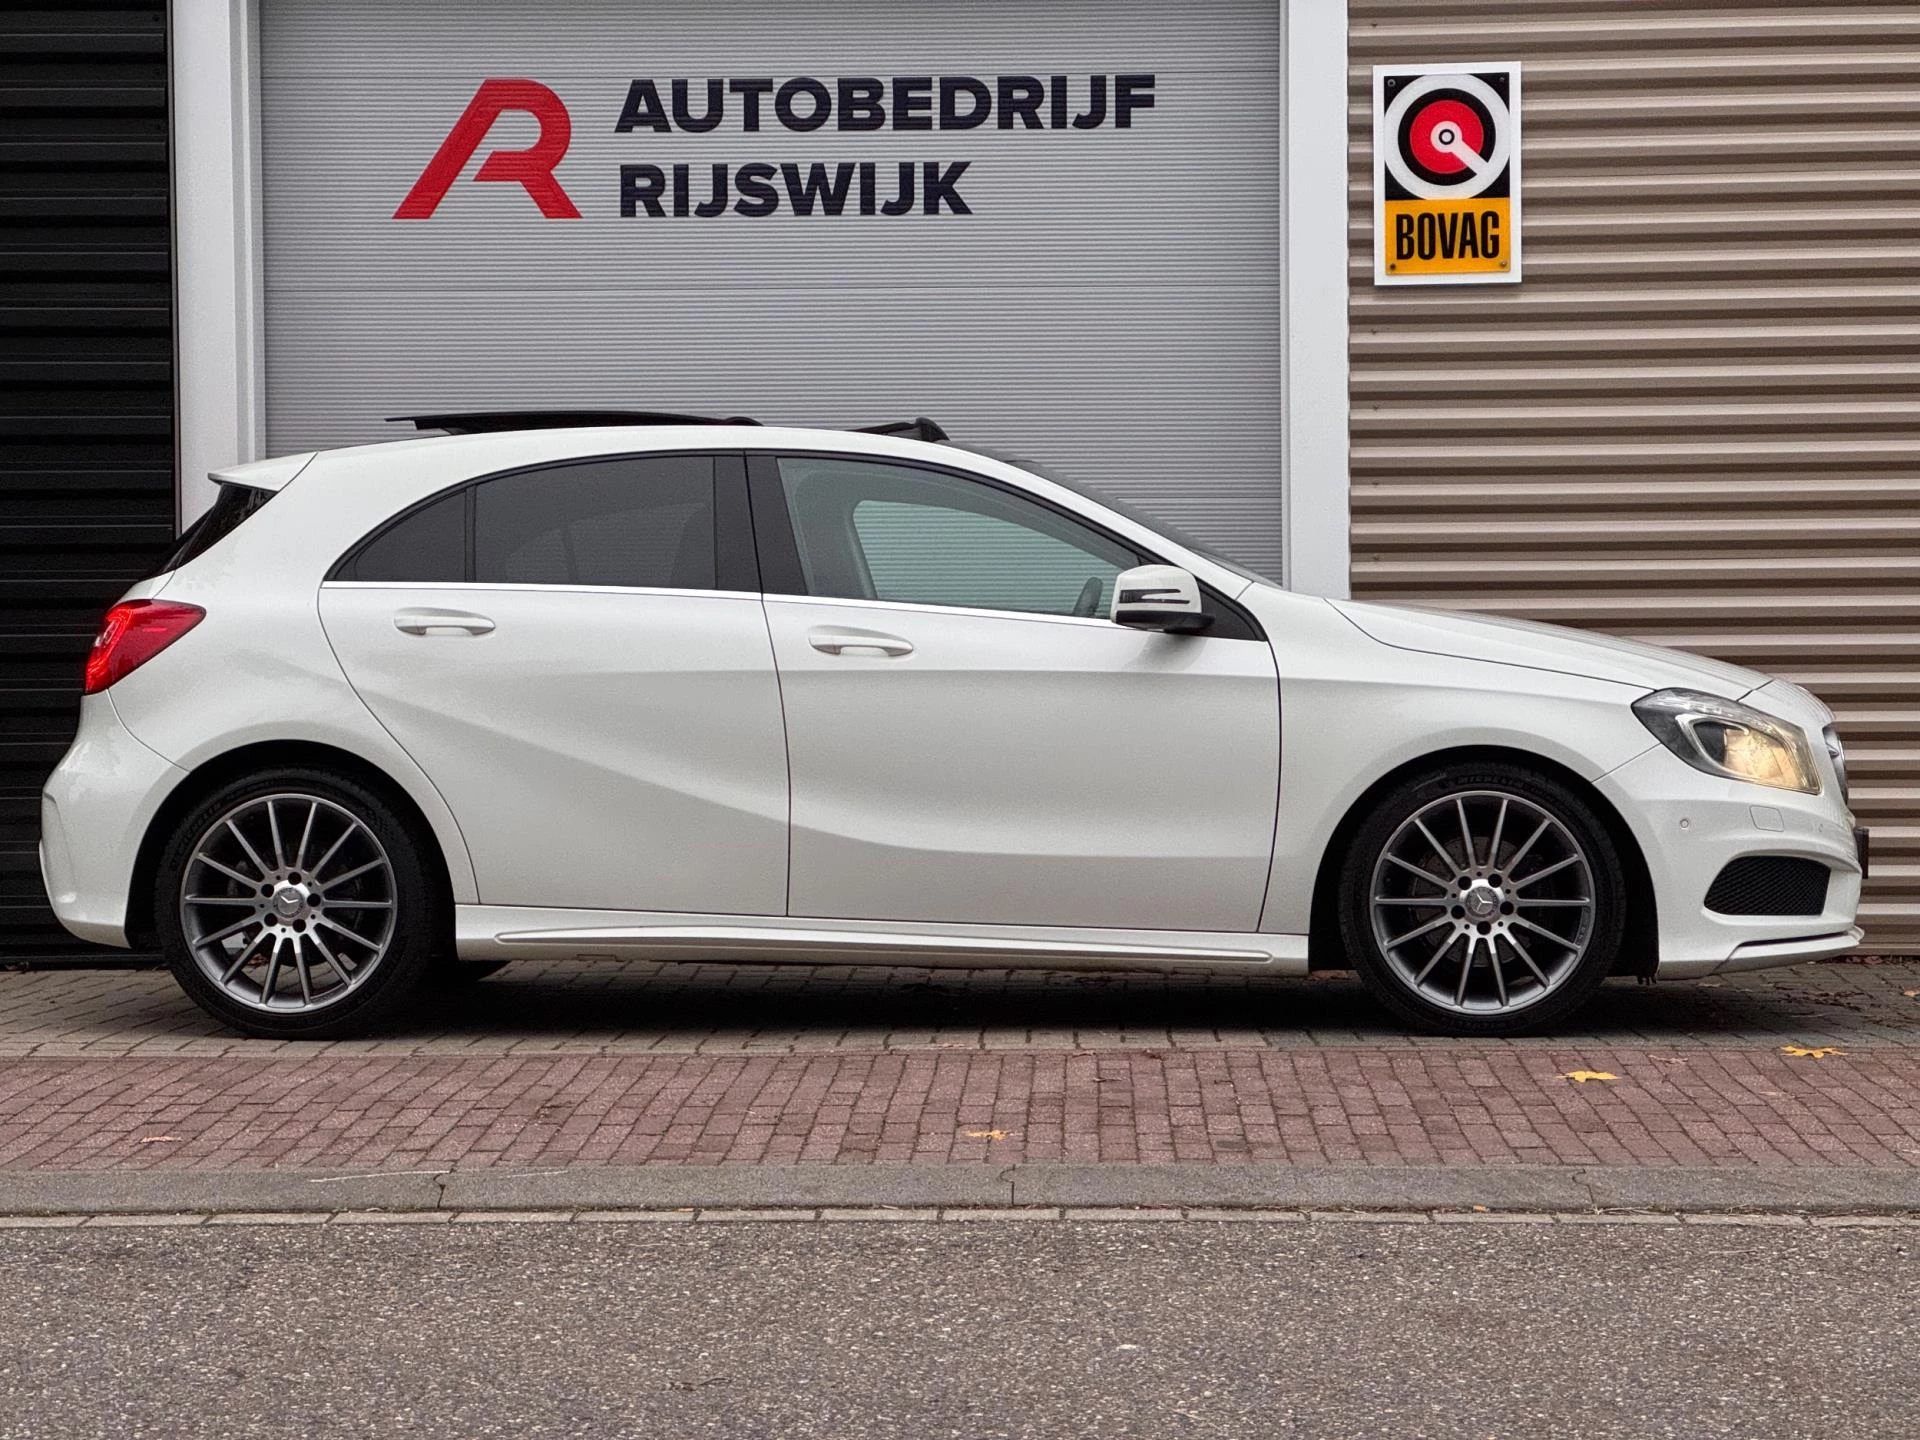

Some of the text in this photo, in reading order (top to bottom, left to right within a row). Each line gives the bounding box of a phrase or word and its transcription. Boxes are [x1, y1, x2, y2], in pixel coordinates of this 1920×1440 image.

[614, 75, 1156, 133] AUTOBEDRIJF
[620, 161, 972, 219] RIJSWIJK
[1396, 211, 1500, 260] BOVAG
